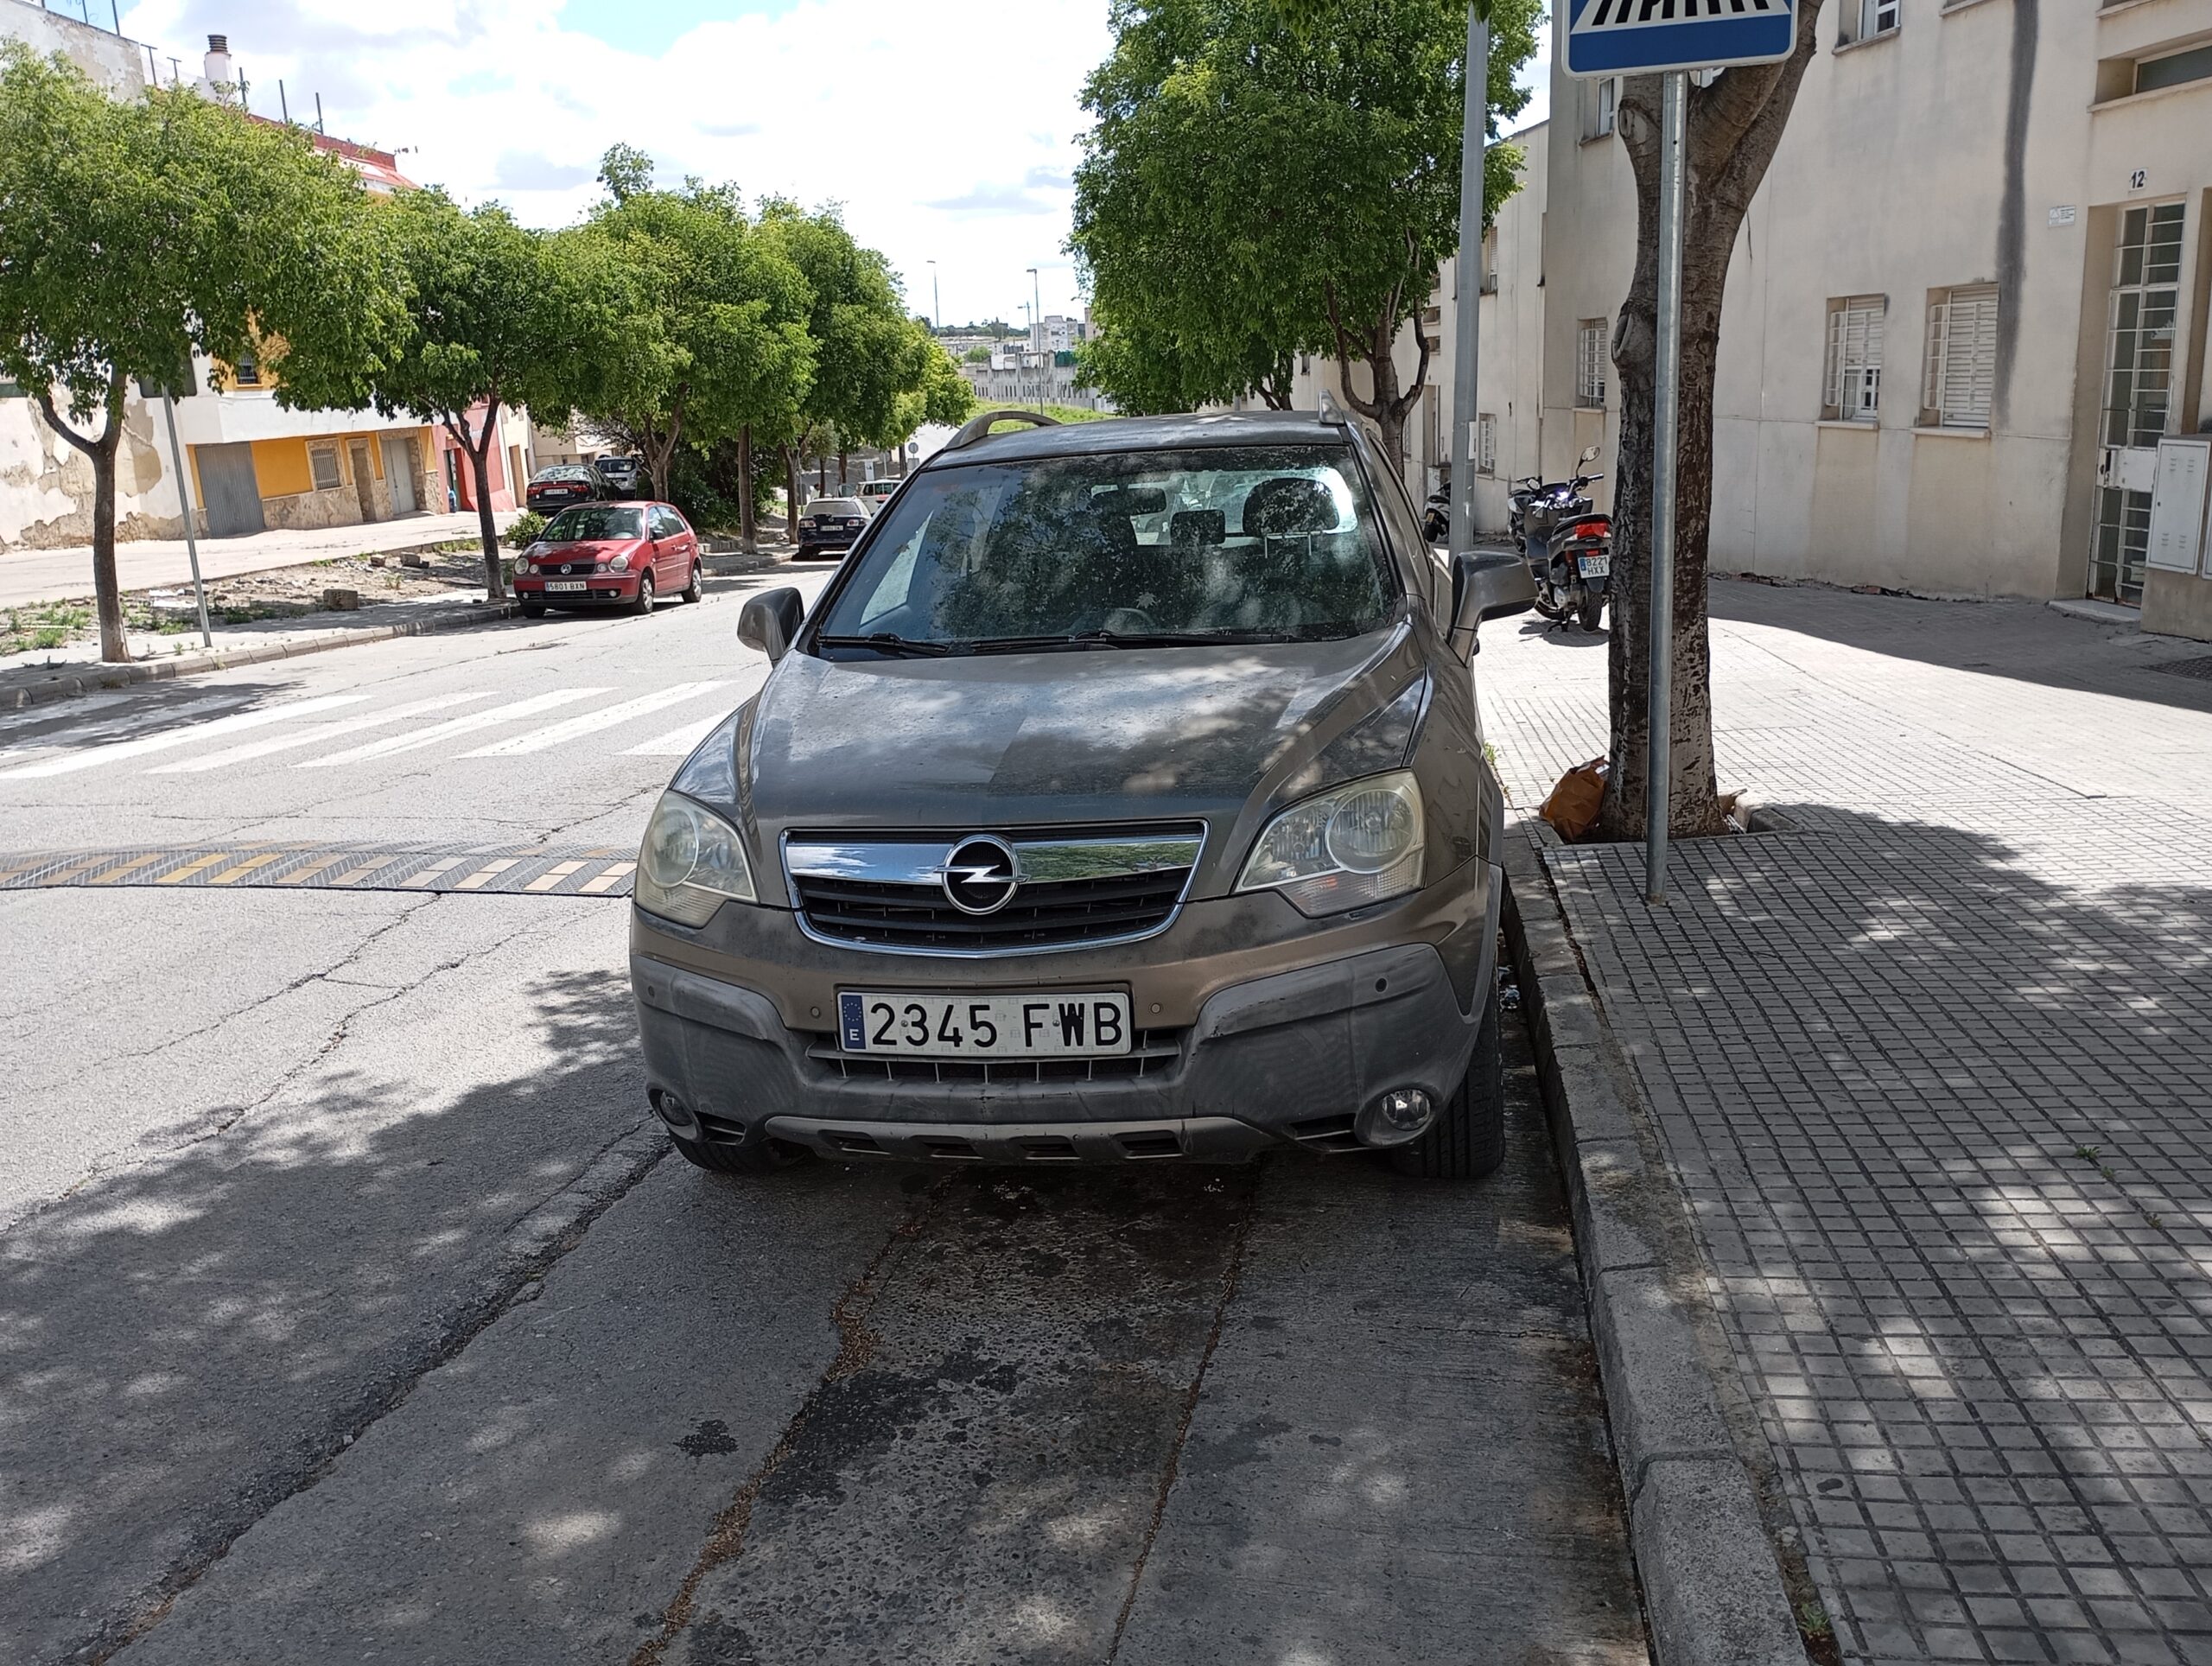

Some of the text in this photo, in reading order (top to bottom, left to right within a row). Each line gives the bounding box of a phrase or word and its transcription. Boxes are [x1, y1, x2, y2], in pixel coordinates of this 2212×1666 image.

[2131, 170, 2145, 189] 12
[1586, 556, 1608, 567] 8221
[1588, 566, 1605, 575] HXX
[870, 1002, 1122, 1048] 2345 FWB
[849, 1028, 860, 1041] E
